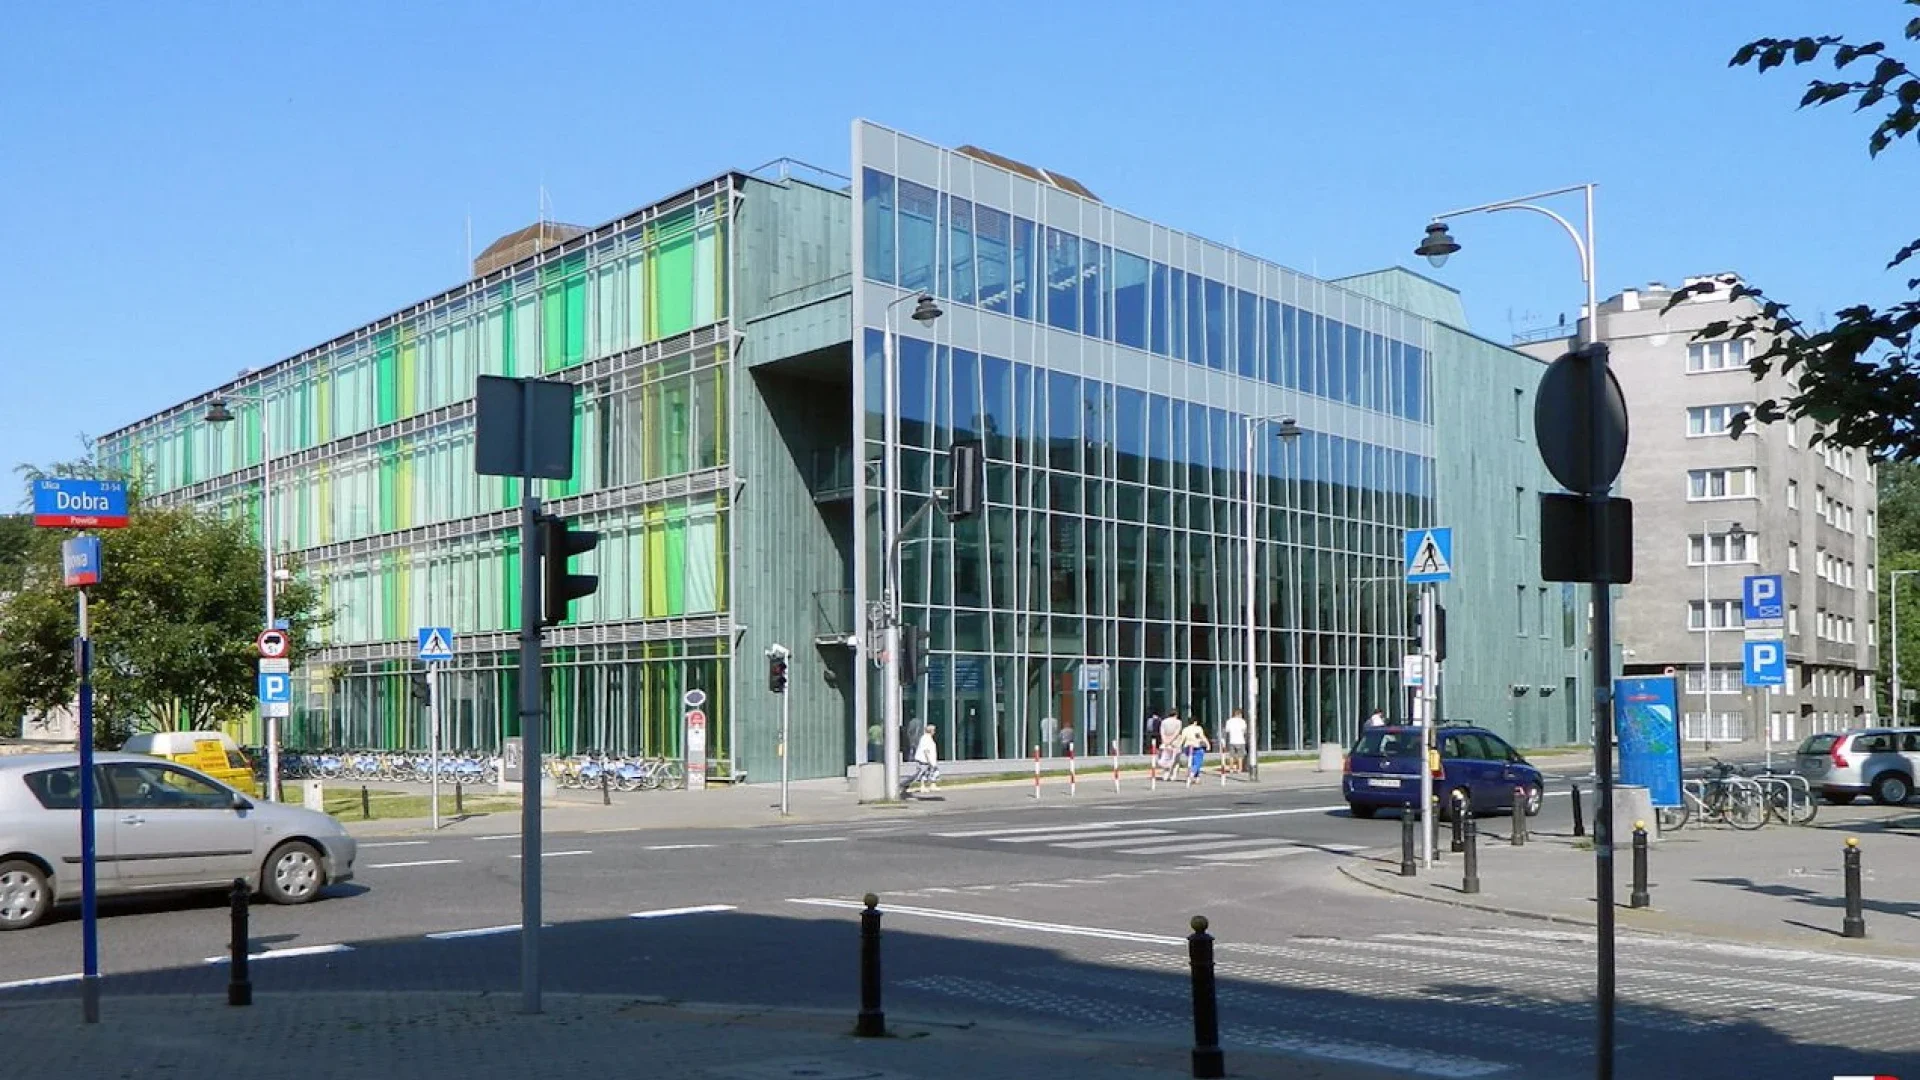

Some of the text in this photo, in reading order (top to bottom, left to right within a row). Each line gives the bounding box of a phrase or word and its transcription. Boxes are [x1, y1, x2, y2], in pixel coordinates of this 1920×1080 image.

[41, 481, 60, 490] Ulica
[57, 491, 109, 510] Dobra
[1753, 579, 1776, 607] P
[1753, 645, 1777, 673] P
[266, 676, 284, 700] P
